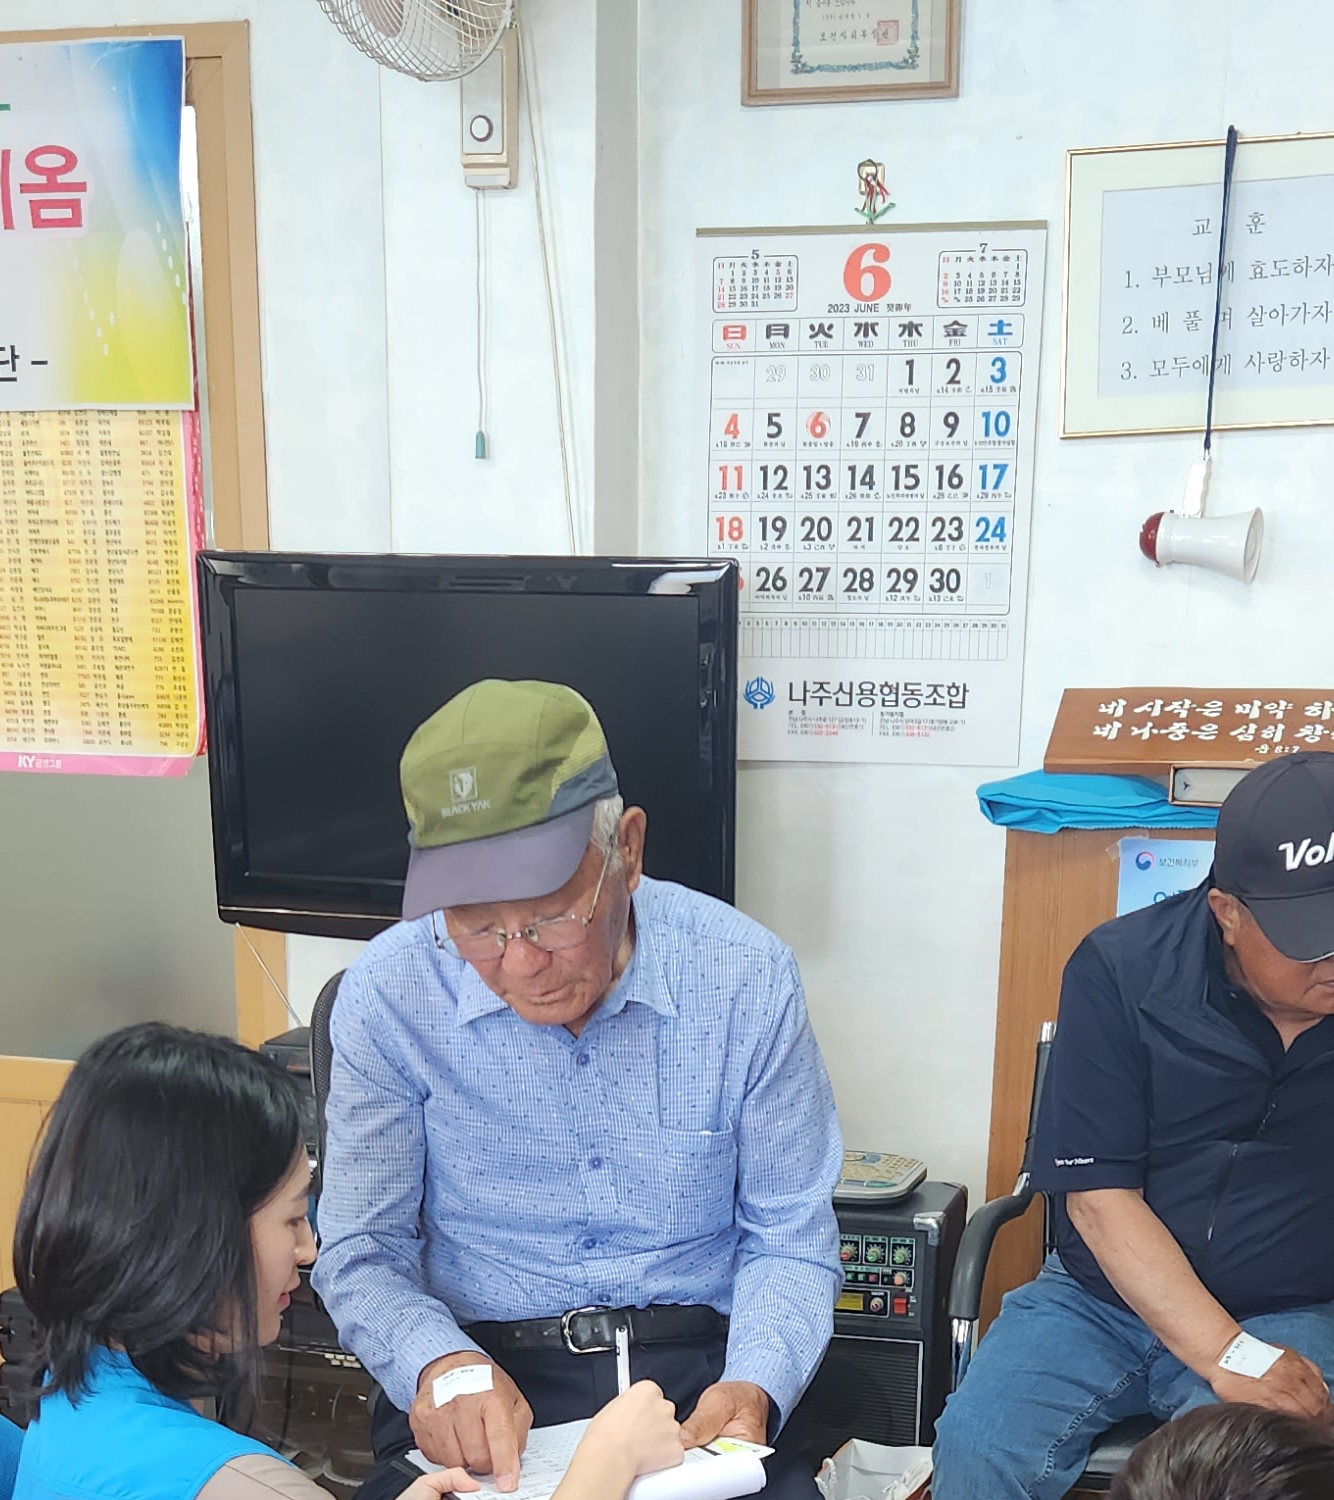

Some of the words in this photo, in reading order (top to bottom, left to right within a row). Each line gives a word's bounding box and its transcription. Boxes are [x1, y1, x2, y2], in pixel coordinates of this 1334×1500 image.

[1192, 218, 1212, 236] 교
[1245, 211, 1266, 235] 훈
[843, 243, 890, 302] 6
[1125, 270, 1140, 289] 1.
[1248, 254, 1334, 281] 효도하자
[827, 303, 850, 313] 2023
[854, 303, 879, 313] JUNE
[1122, 315, 1139, 334] 2.
[1247, 301, 1333, 328] 살아가자
[722, 324, 747, 341] 日
[765, 323, 790, 339] 月
[809, 322, 834, 339] 火
[854, 321, 879, 338] 水
[898, 320, 923, 337] 木
[943, 320, 968, 337] 金
[987, 319, 1013, 335] 土
[769, 341, 785, 349] MON
[814, 340, 828, 348] TUE
[858, 340, 874, 348] WED
[903, 339, 918, 347] THU
[993, 337, 1008, 345] SAT
[810, 364, 830, 381] 30
[905, 359, 915, 385] 1
[946, 358, 961, 385] 2
[990, 356, 1007, 384] 3
[1120, 361, 1137, 381] 3.
[1244, 347, 1331, 374] 사랑하자
[724, 413, 740, 440] 4
[767, 412, 783, 439] 5
[810, 411, 827, 439] 6
[855, 412, 872, 439] 7
[900, 411, 916, 438] 8
[943, 411, 960, 438] 9
[982, 410, 1011, 437] 10
[719, 465, 743, 491] 11
[759, 464, 789, 491] 12
[803, 464, 832, 491] 13
[848, 464, 876, 491] 14
[891, 464, 921, 491] 15
[935, 463, 964, 490] 16
[979, 463, 1009, 490] 17
[716, 516, 744, 542] 18
[759, 516, 787, 542] 19
[800, 516, 833, 542] 20
[846, 516, 874, 542] 21
[888, 516, 920, 542] 22
[931, 516, 964, 542] 23
[975, 516, 1007, 542] 24
[755, 567, 787, 592] 26
[798, 567, 832, 592] 27
[842, 567, 874, 593] 28
[886, 567, 919, 593] 29
[929, 568, 961, 594] 30
[788, 680, 969, 709] 나주신용협동조합
[1098, 699, 1127, 718] 네
[1133, 699, 1223, 718] 시작은
[1234, 699, 1294, 719] 미약
[1093, 721, 1122, 741] 네
[1130, 721, 1220, 742] 나중은
[1230, 723, 1285, 742] 심히
